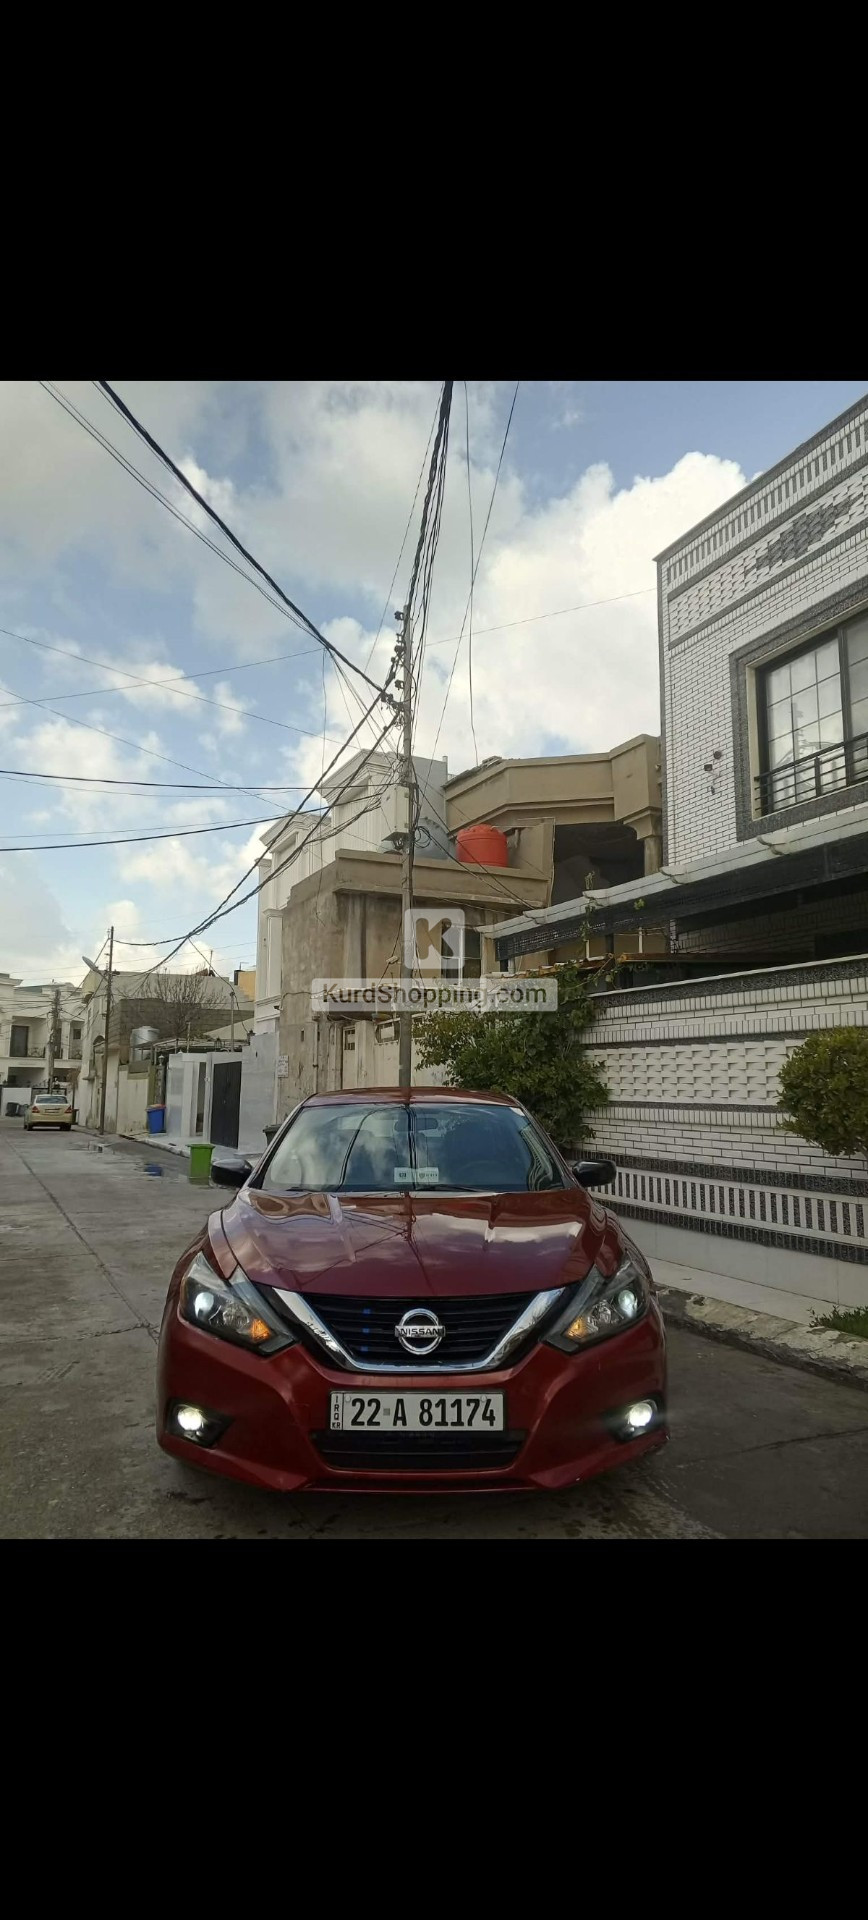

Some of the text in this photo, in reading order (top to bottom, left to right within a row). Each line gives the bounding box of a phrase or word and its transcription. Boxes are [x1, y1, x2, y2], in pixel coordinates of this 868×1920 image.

[400, 1328, 440, 1336] NISSAN
[351, 1398, 496, 1427] 22 A 81174
